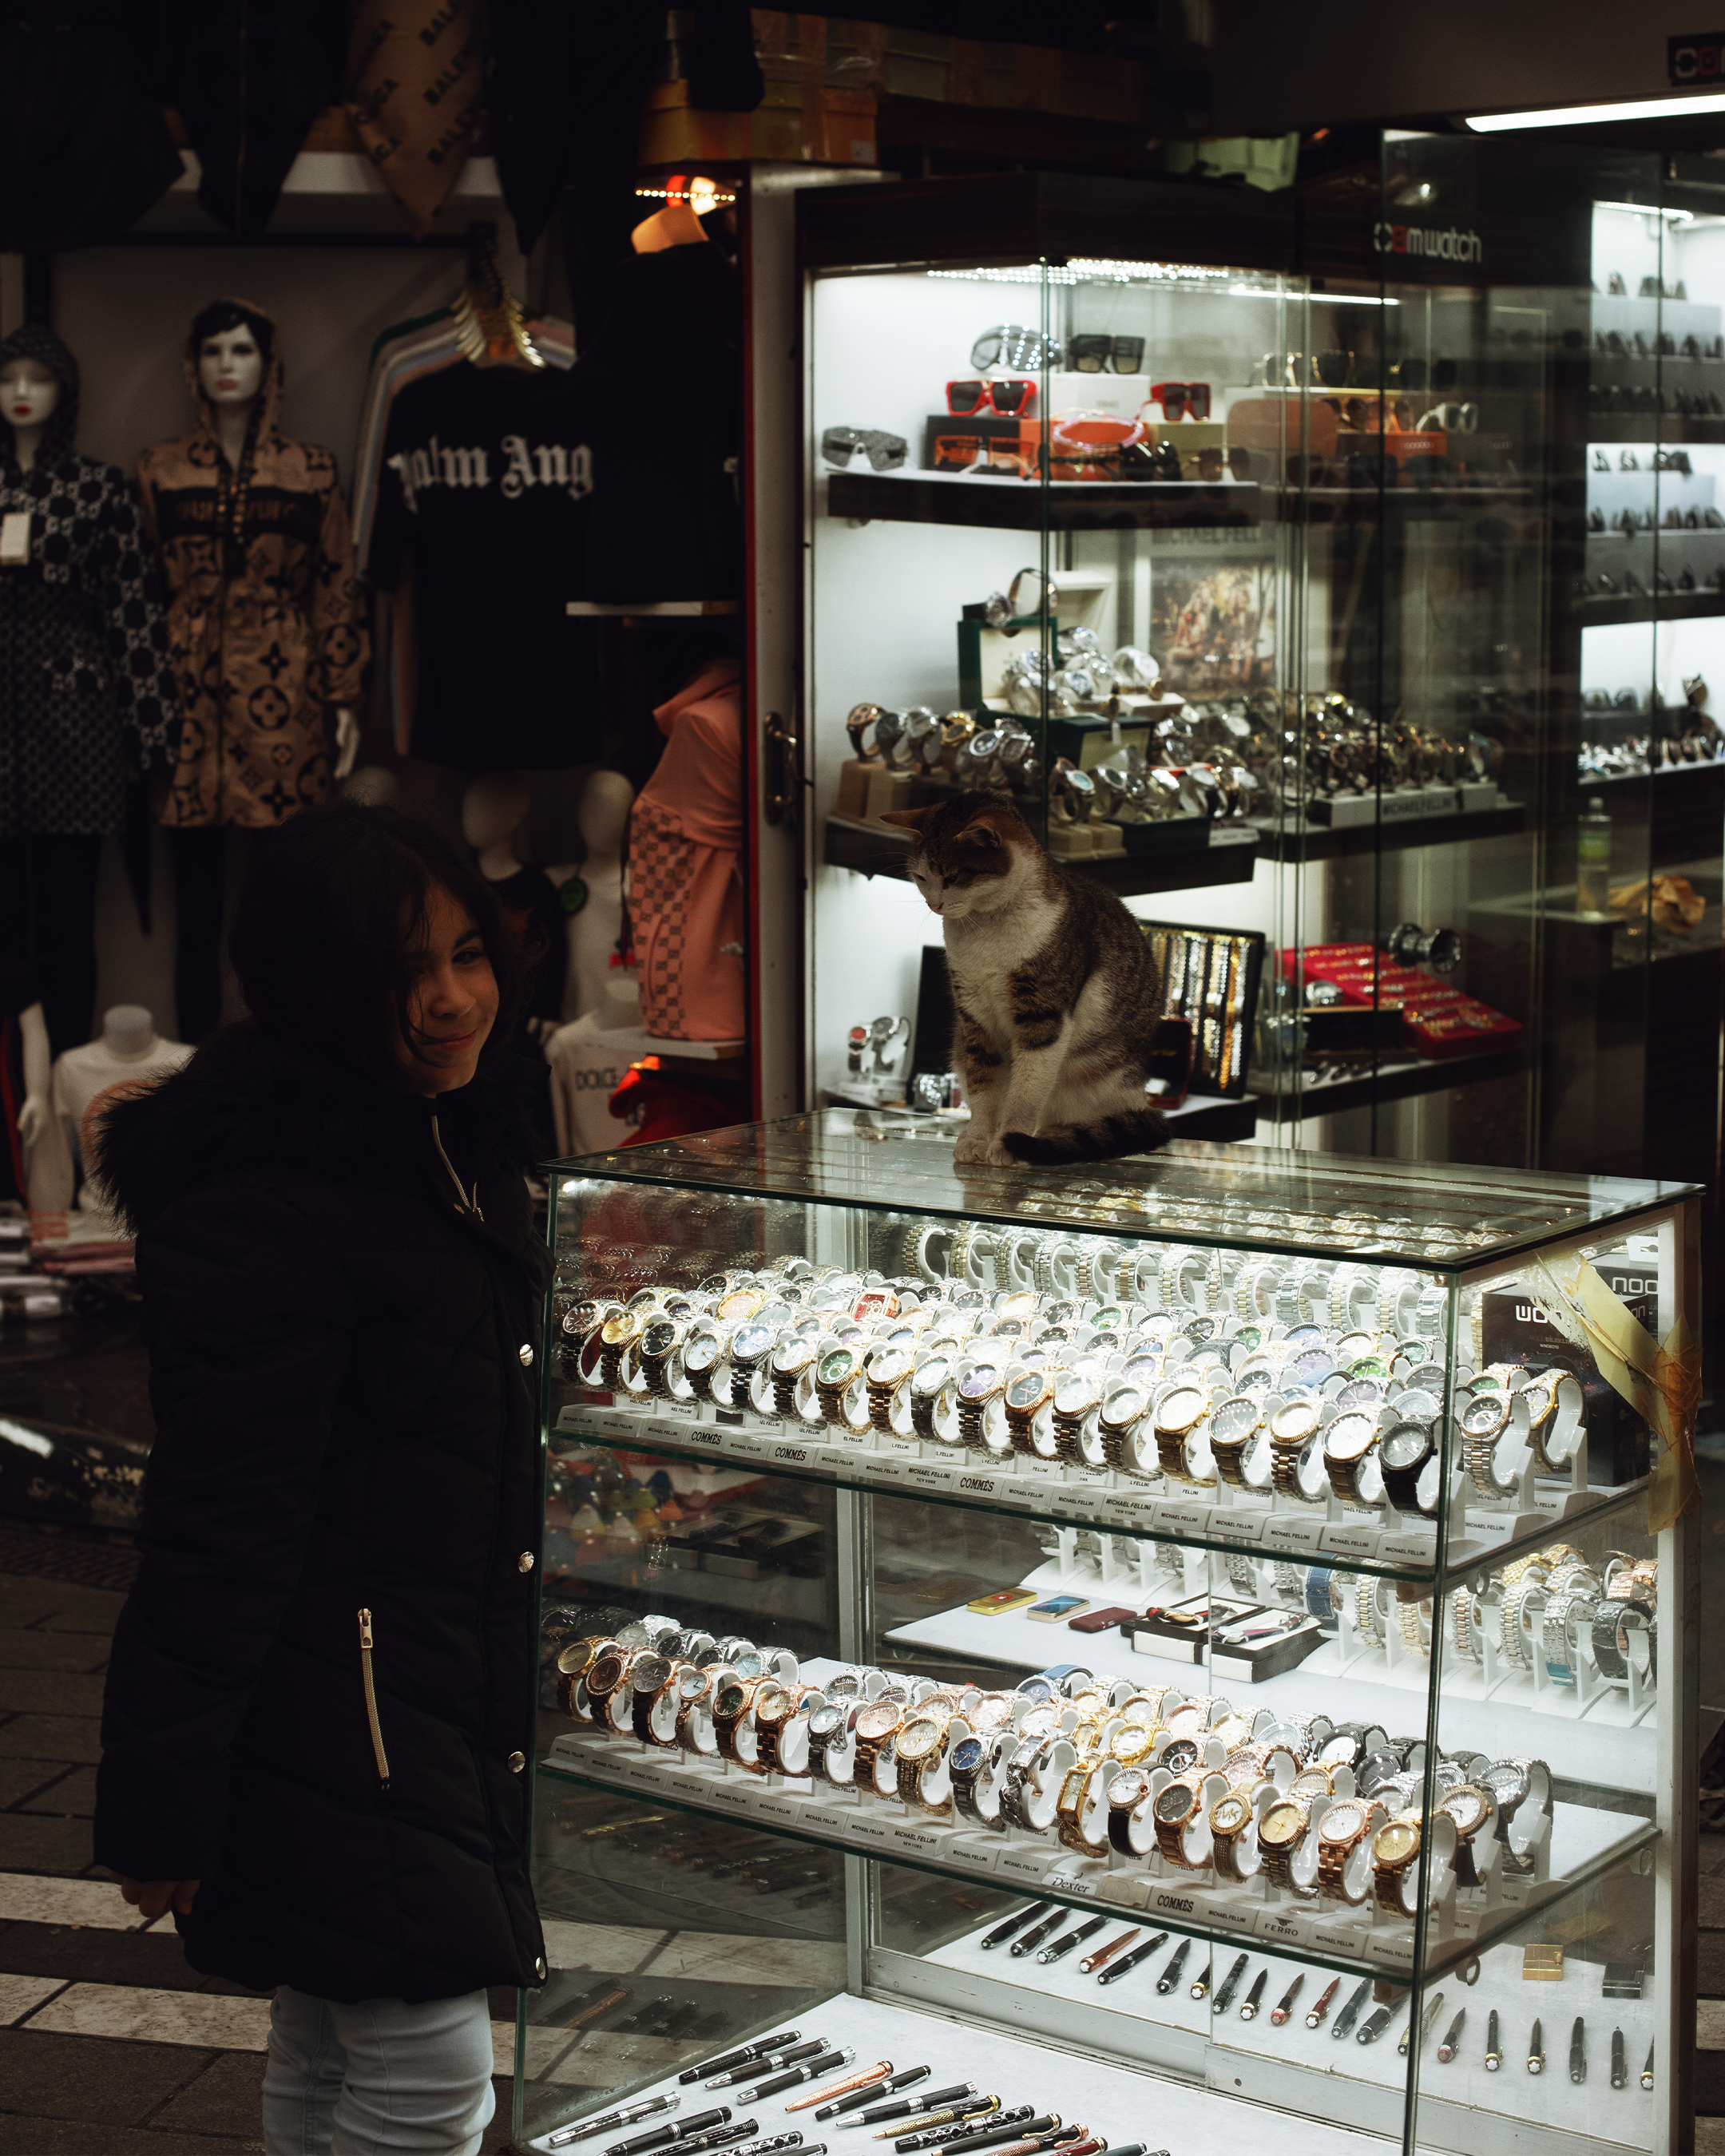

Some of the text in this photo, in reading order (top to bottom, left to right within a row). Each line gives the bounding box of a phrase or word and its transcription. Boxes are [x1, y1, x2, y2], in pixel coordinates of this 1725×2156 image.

[500, 434, 594, 502] Ang
[908, 1467, 951, 1479] MICHAEL FELLINI
[1105, 1498, 1152, 1511] MICHAEL FELLINI
[1215, 1519, 1235, 1528] MICHAEL
[1465, 1521, 1486, 1530] MICHAEL
[1271, 1529, 1291, 1538] MICHAEL
[1385, 1546, 1407, 1555] MICHAEL
[759, 1803, 776, 1812] MICHAEL
[805, 1813, 822, 1822] MICHAEL
[851, 1824, 869, 1833] MICHAEL
[894, 1829, 937, 1845] MICHAEL FELLINI
[953, 1849, 988, 1862] MICHAEL FELLINI
[1004, 1859, 1022, 1869] MICHAEL
[1052, 1877, 1090, 1893] Dexter
[1208, 1909, 1247, 1923] MICHAEL FELLINI
[1315, 1935, 1337, 1945] MICHAEL
[1373, 1946, 1394, 1955] MICHAEL
